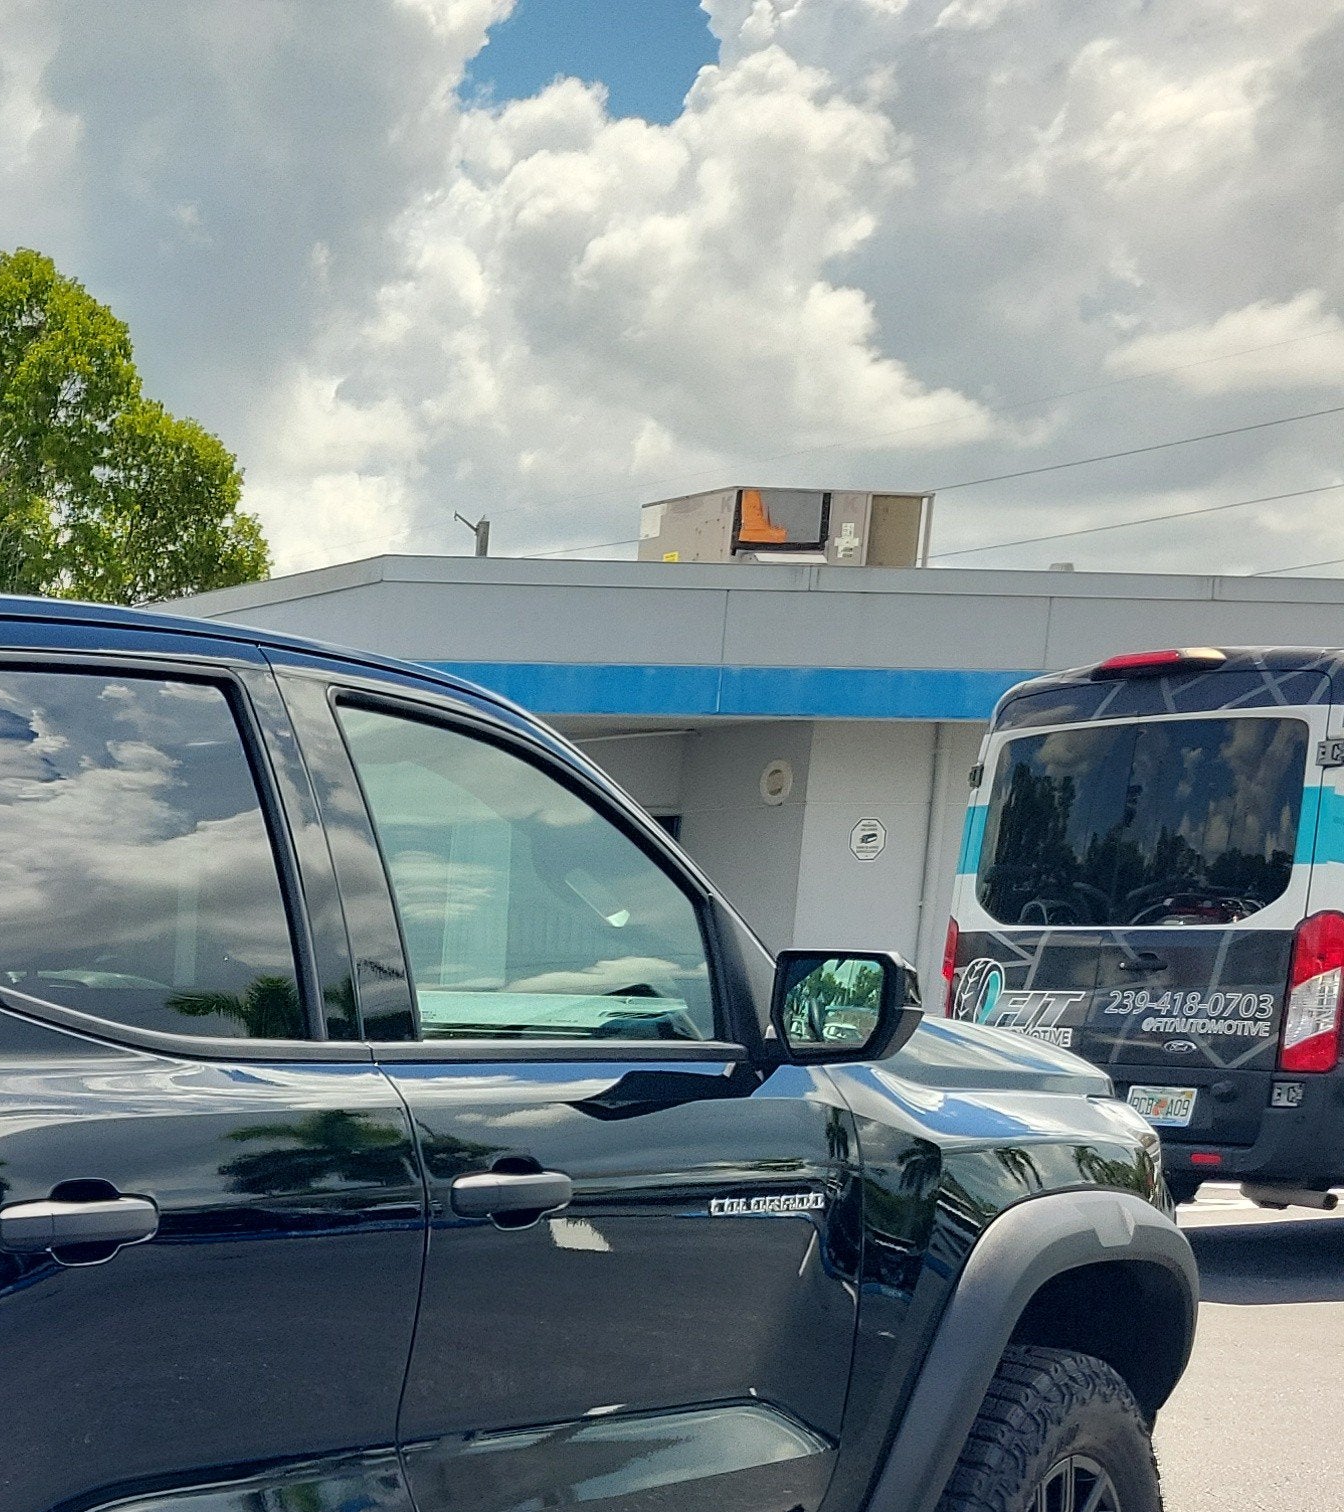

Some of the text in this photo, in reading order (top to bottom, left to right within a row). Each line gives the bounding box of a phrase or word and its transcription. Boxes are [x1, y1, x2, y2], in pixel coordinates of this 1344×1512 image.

[984, 990, 1086, 1027] FIT
[1104, 990, 1274, 1019] 239-418-0703
[1141, 1017, 1271, 1037] @FITAUTOMOTIVE
[1166, 1098, 1190, 1117] A09
